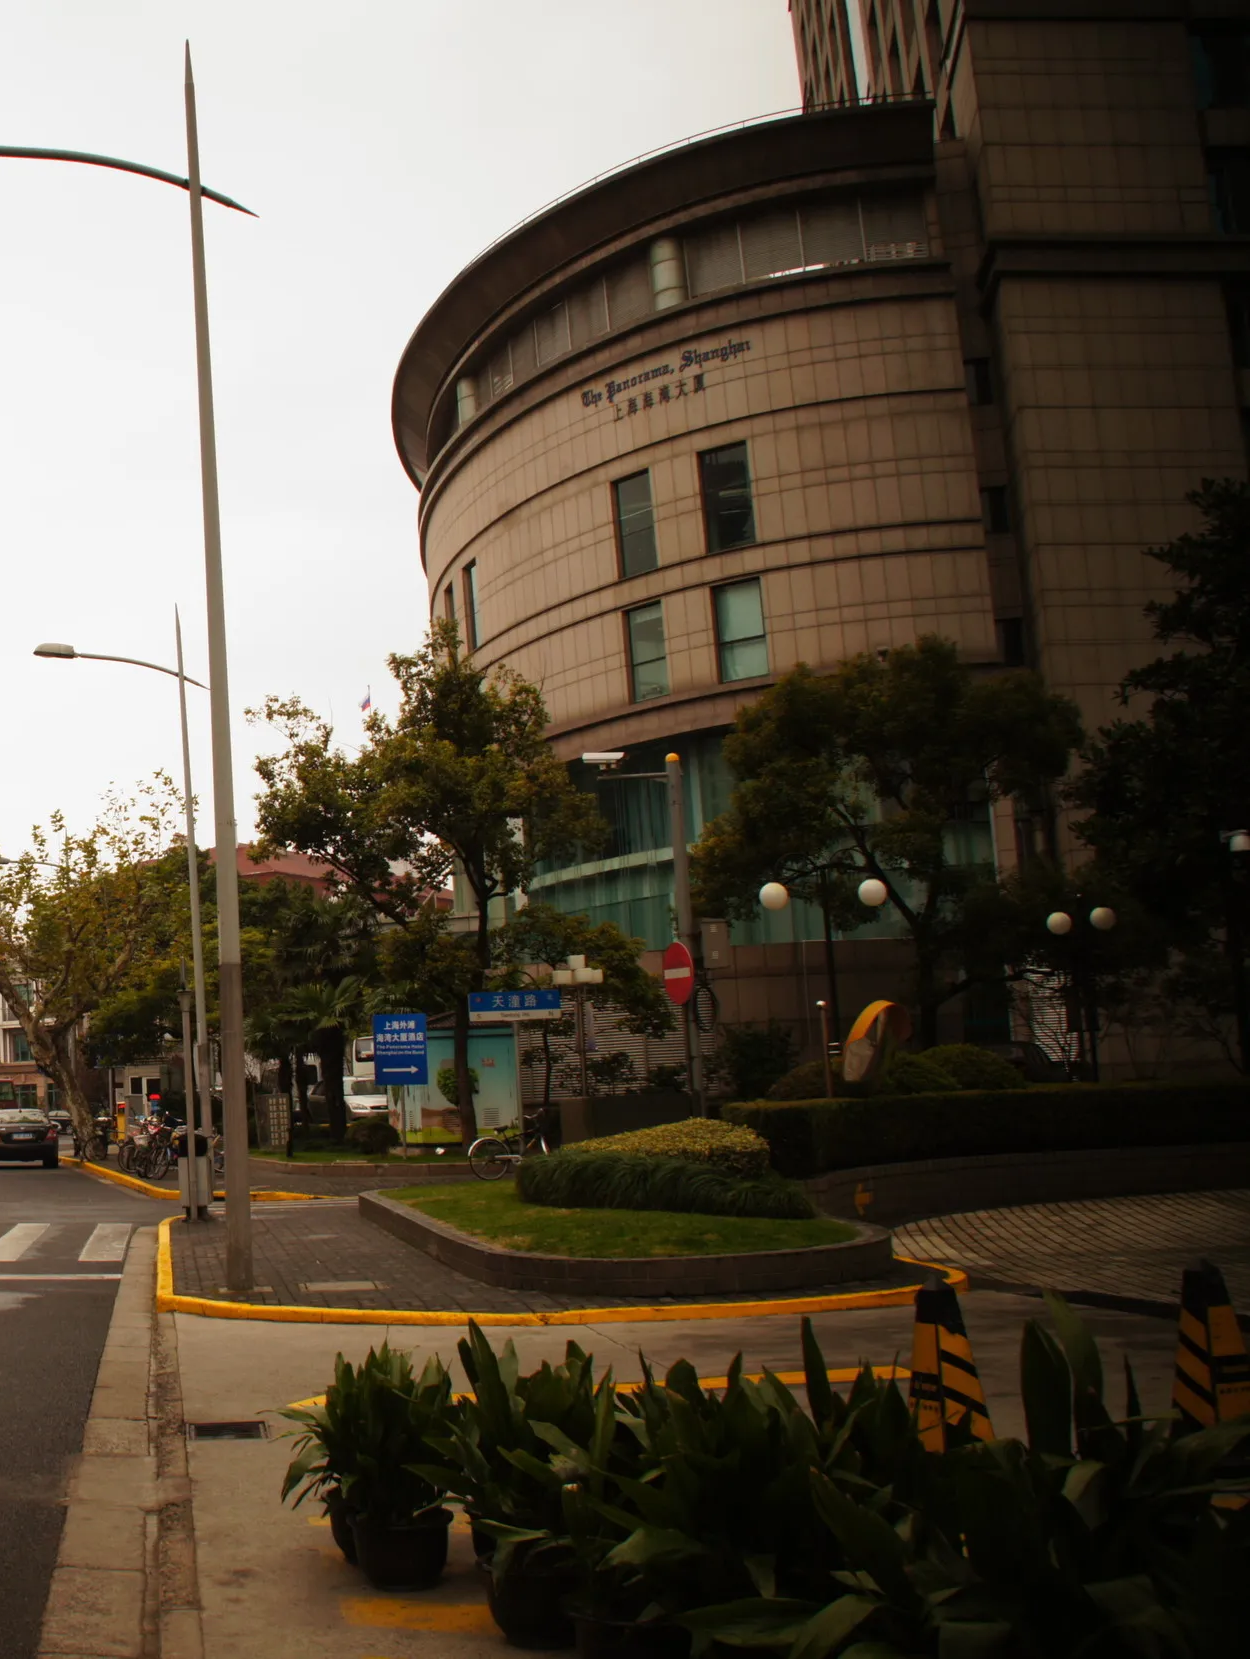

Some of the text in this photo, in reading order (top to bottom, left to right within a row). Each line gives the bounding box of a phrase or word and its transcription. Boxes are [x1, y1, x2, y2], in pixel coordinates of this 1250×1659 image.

[581, 339, 751, 407] The Panorama, Shanghai
[492, 994, 538, 1008] 天潼路
[383, 1020, 415, 1030] 上海外滩
[376, 1032, 424, 1042] 海湾大厦酒店
